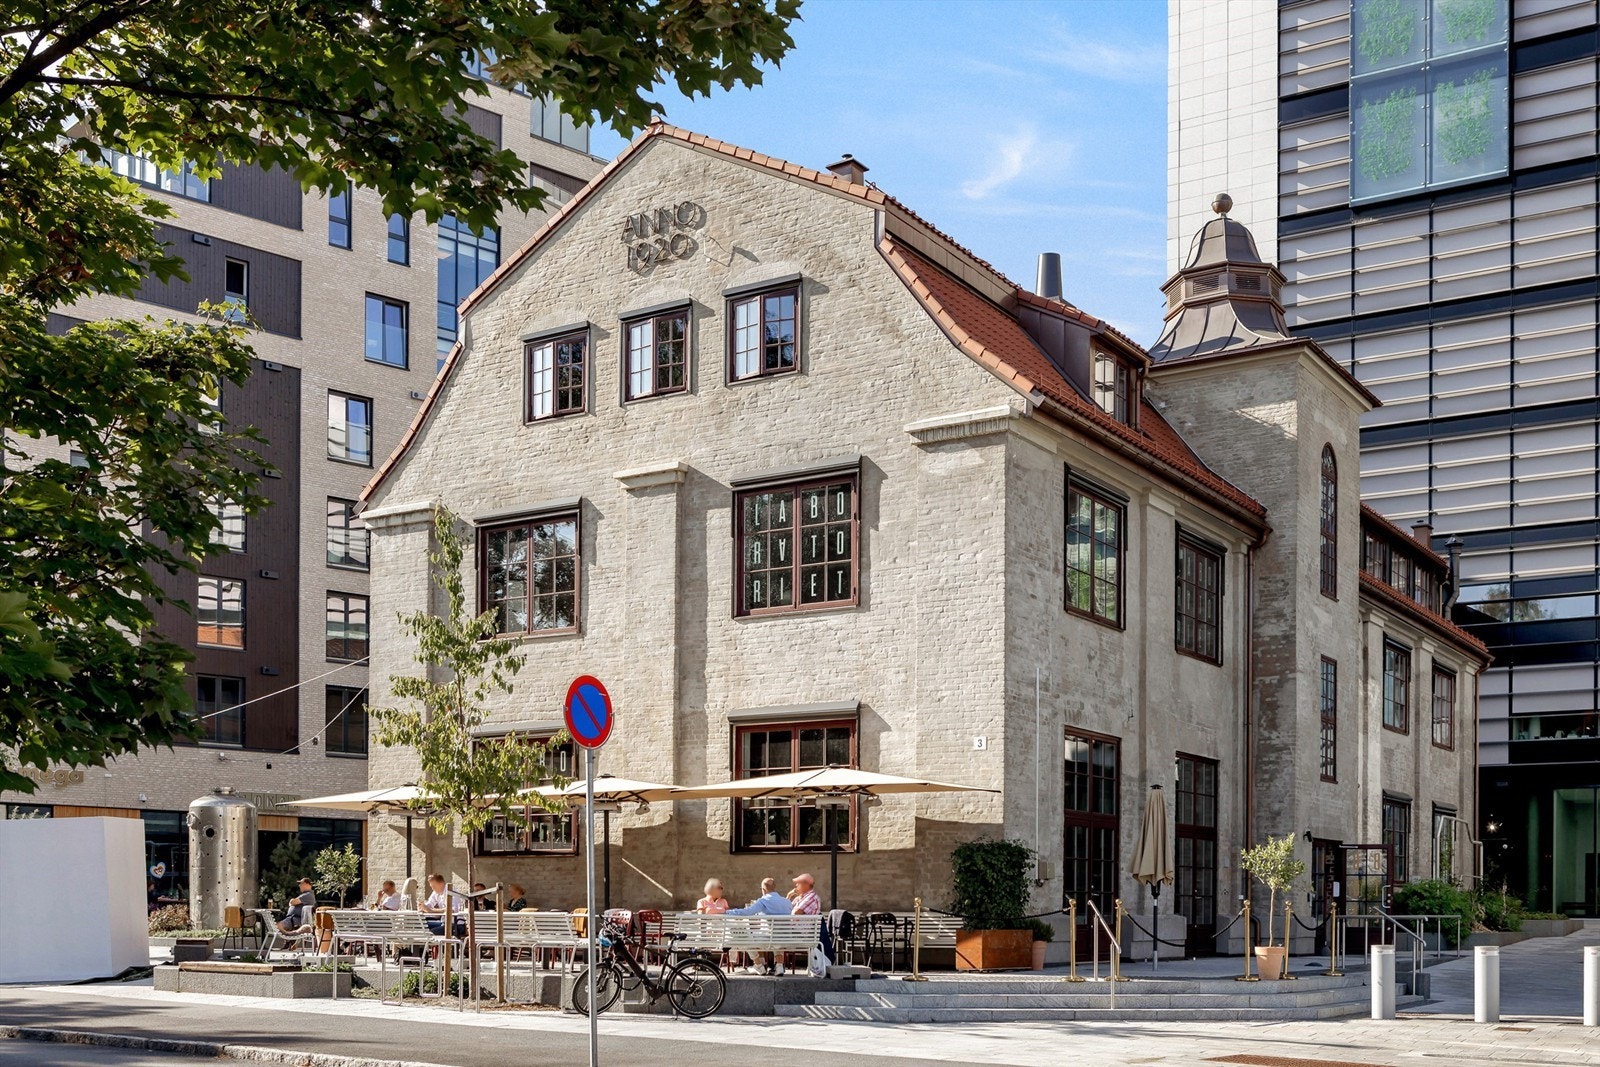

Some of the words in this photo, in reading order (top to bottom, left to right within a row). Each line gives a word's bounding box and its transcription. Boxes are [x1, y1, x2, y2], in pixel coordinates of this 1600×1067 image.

[621, 200, 696, 241] ANNO
[627, 232, 689, 274] 1920
[754, 491, 844, 526] LABO
[753, 570, 844, 603] RIET
[977, 738, 983, 748] 3
